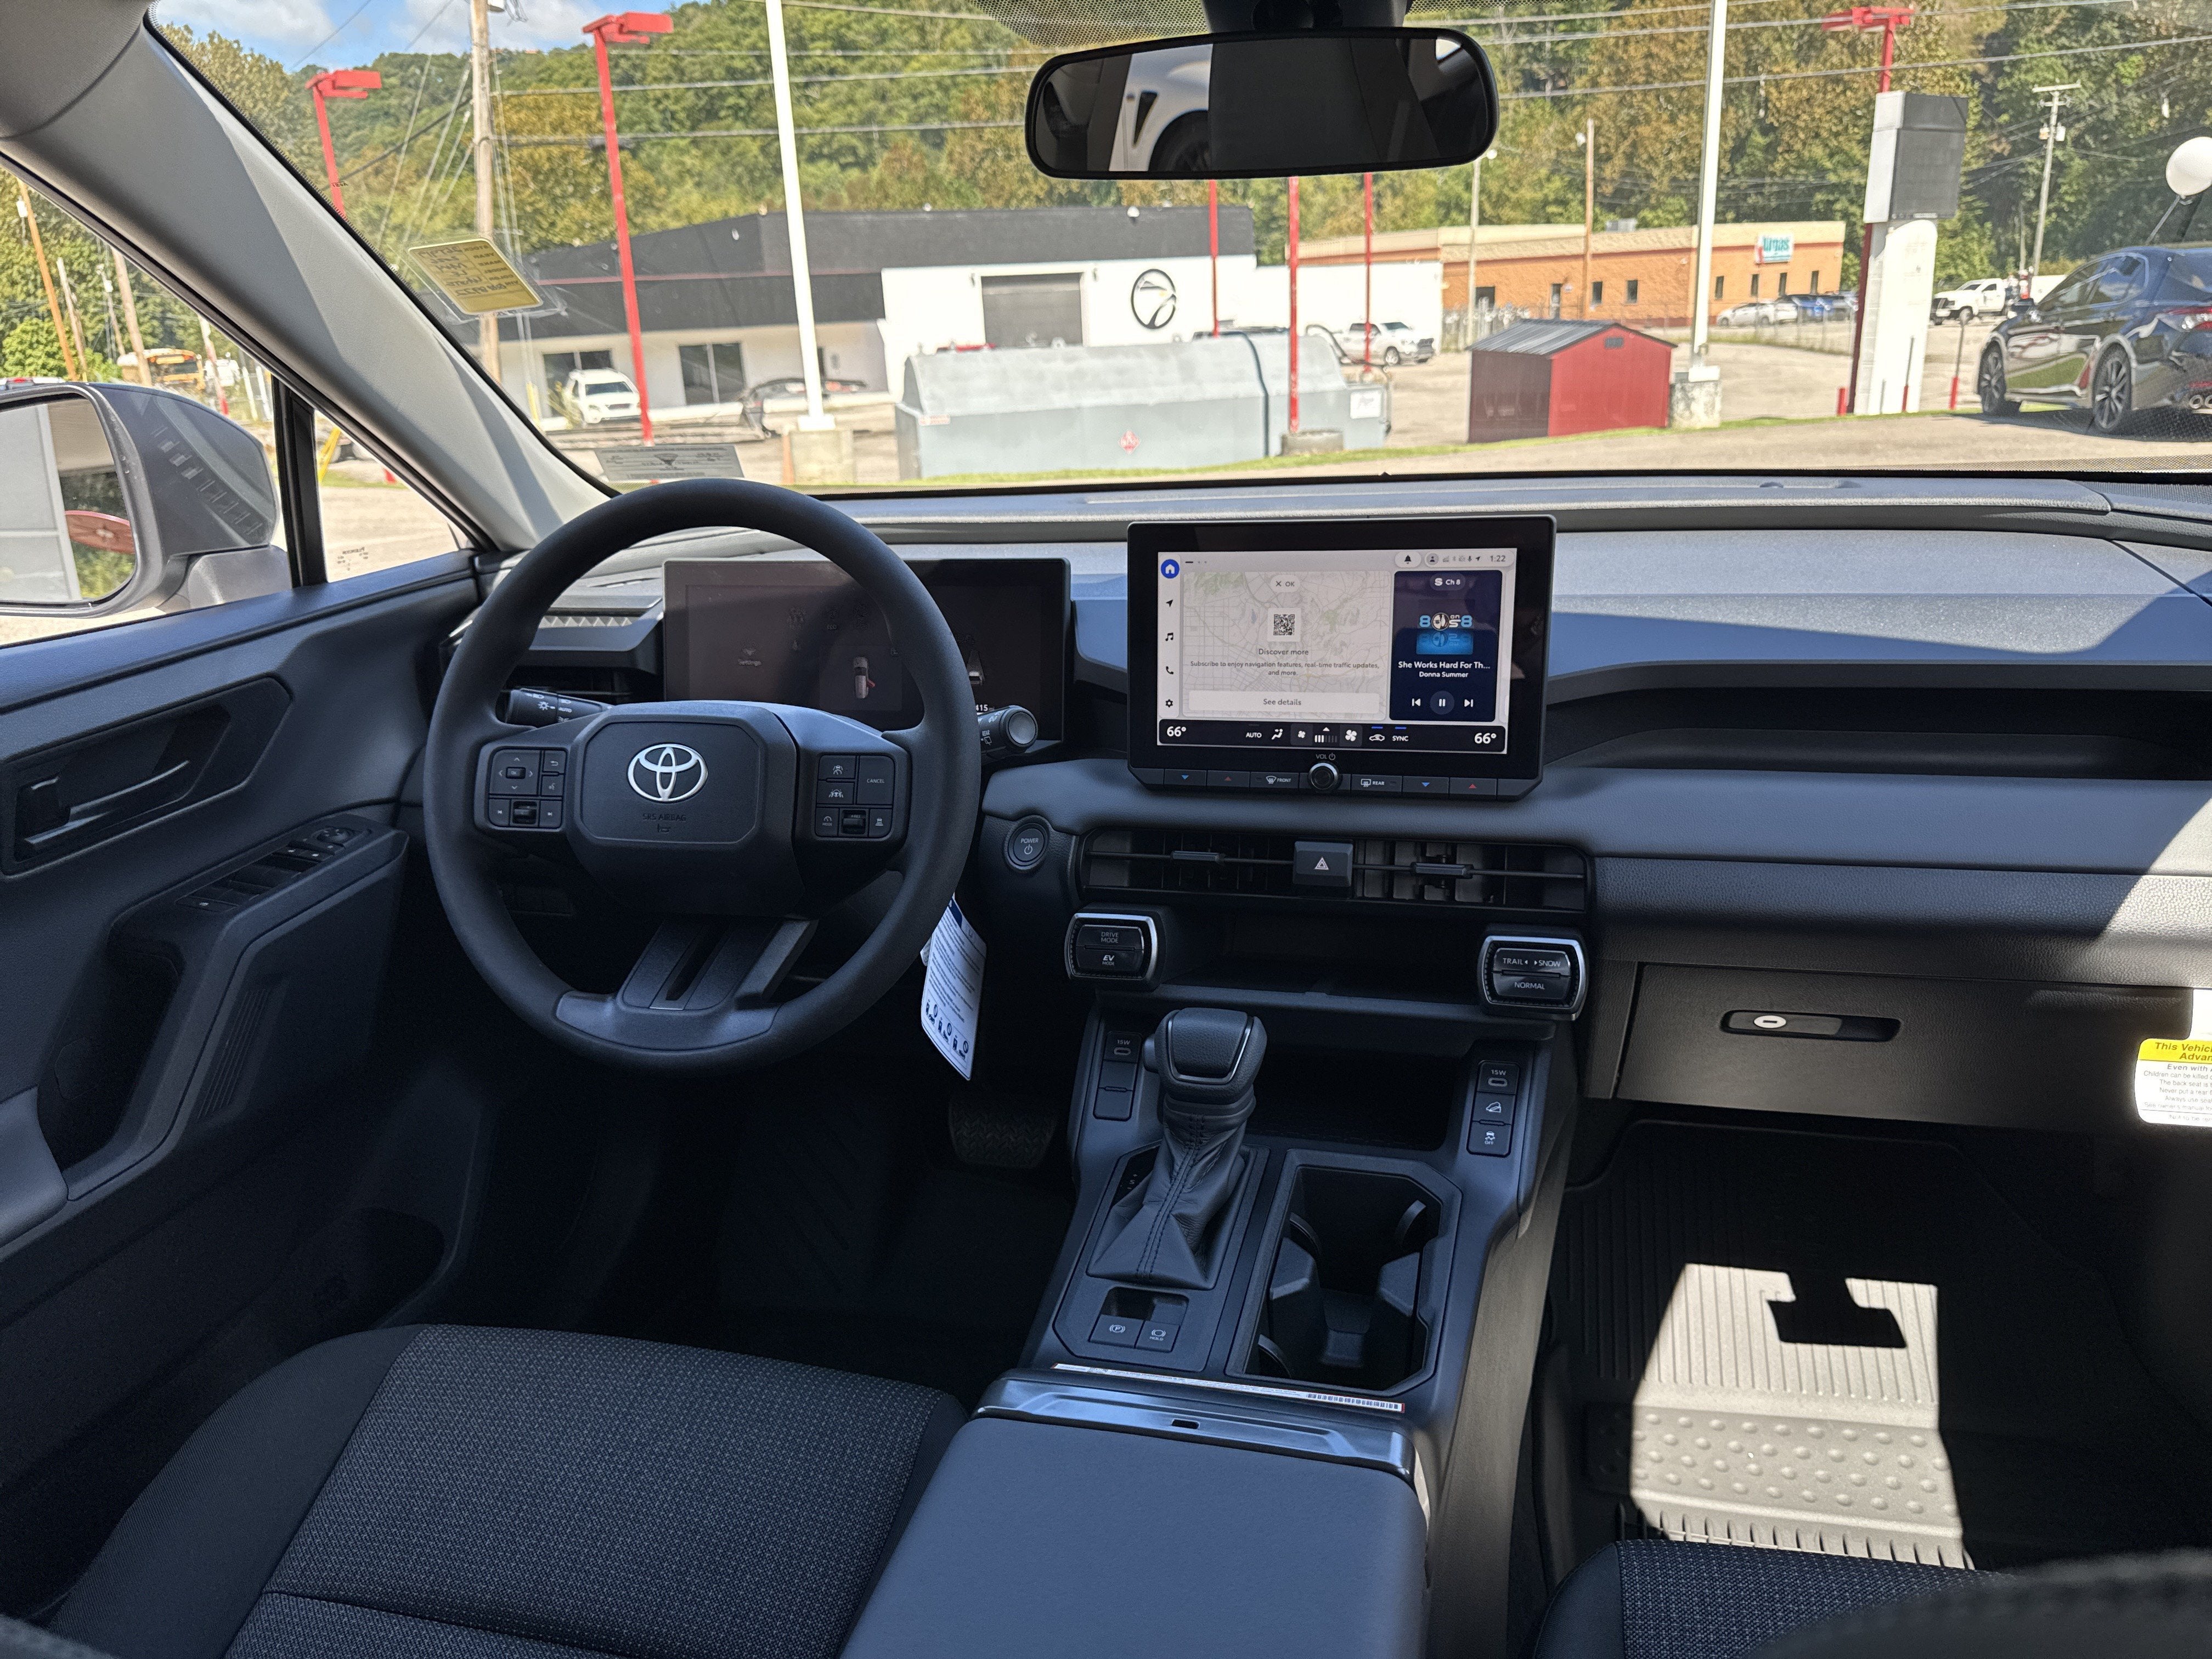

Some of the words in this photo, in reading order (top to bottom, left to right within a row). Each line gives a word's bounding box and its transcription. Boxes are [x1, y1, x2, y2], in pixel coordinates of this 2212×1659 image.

[1166, 726, 1187, 737] 66°
[1474, 733, 1497, 744] 66°
[2155, 1042, 2178, 1051] This
